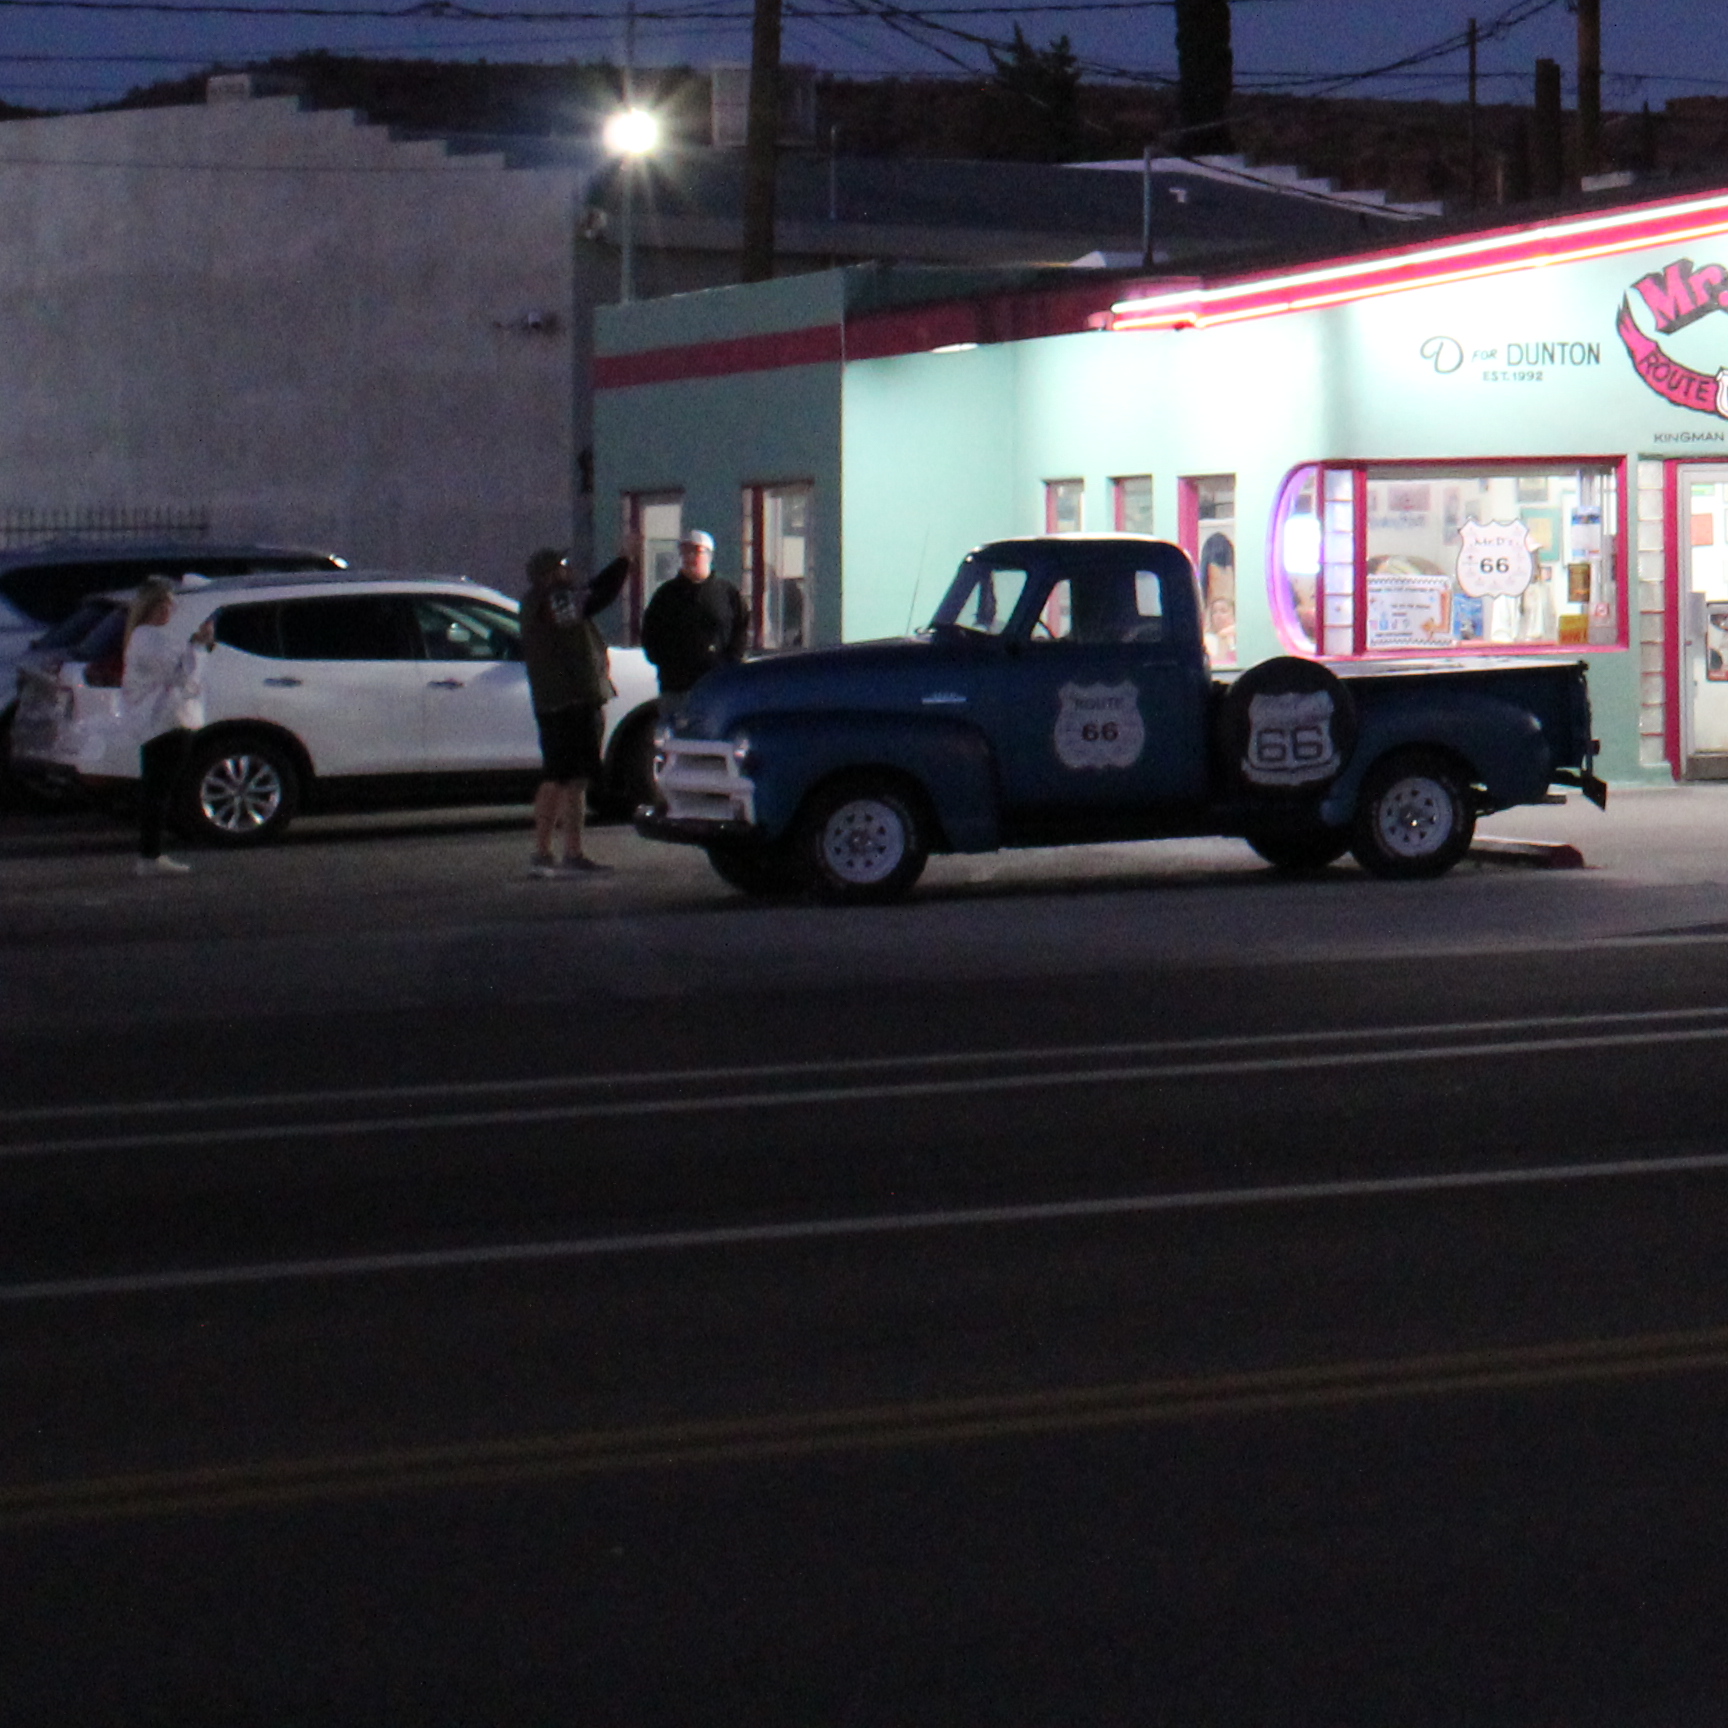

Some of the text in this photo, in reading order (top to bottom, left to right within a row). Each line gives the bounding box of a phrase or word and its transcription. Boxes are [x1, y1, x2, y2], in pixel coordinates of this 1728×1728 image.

[1420, 335, 1601, 374] D FOR DUNTON
[1638, 351, 1711, 403] ROUTE
[1654, 431, 1725, 443] KINGMAN
[1479, 556, 1509, 574] 66
[1081, 721, 1120, 743] 66
[1256, 725, 1325, 762] 66
